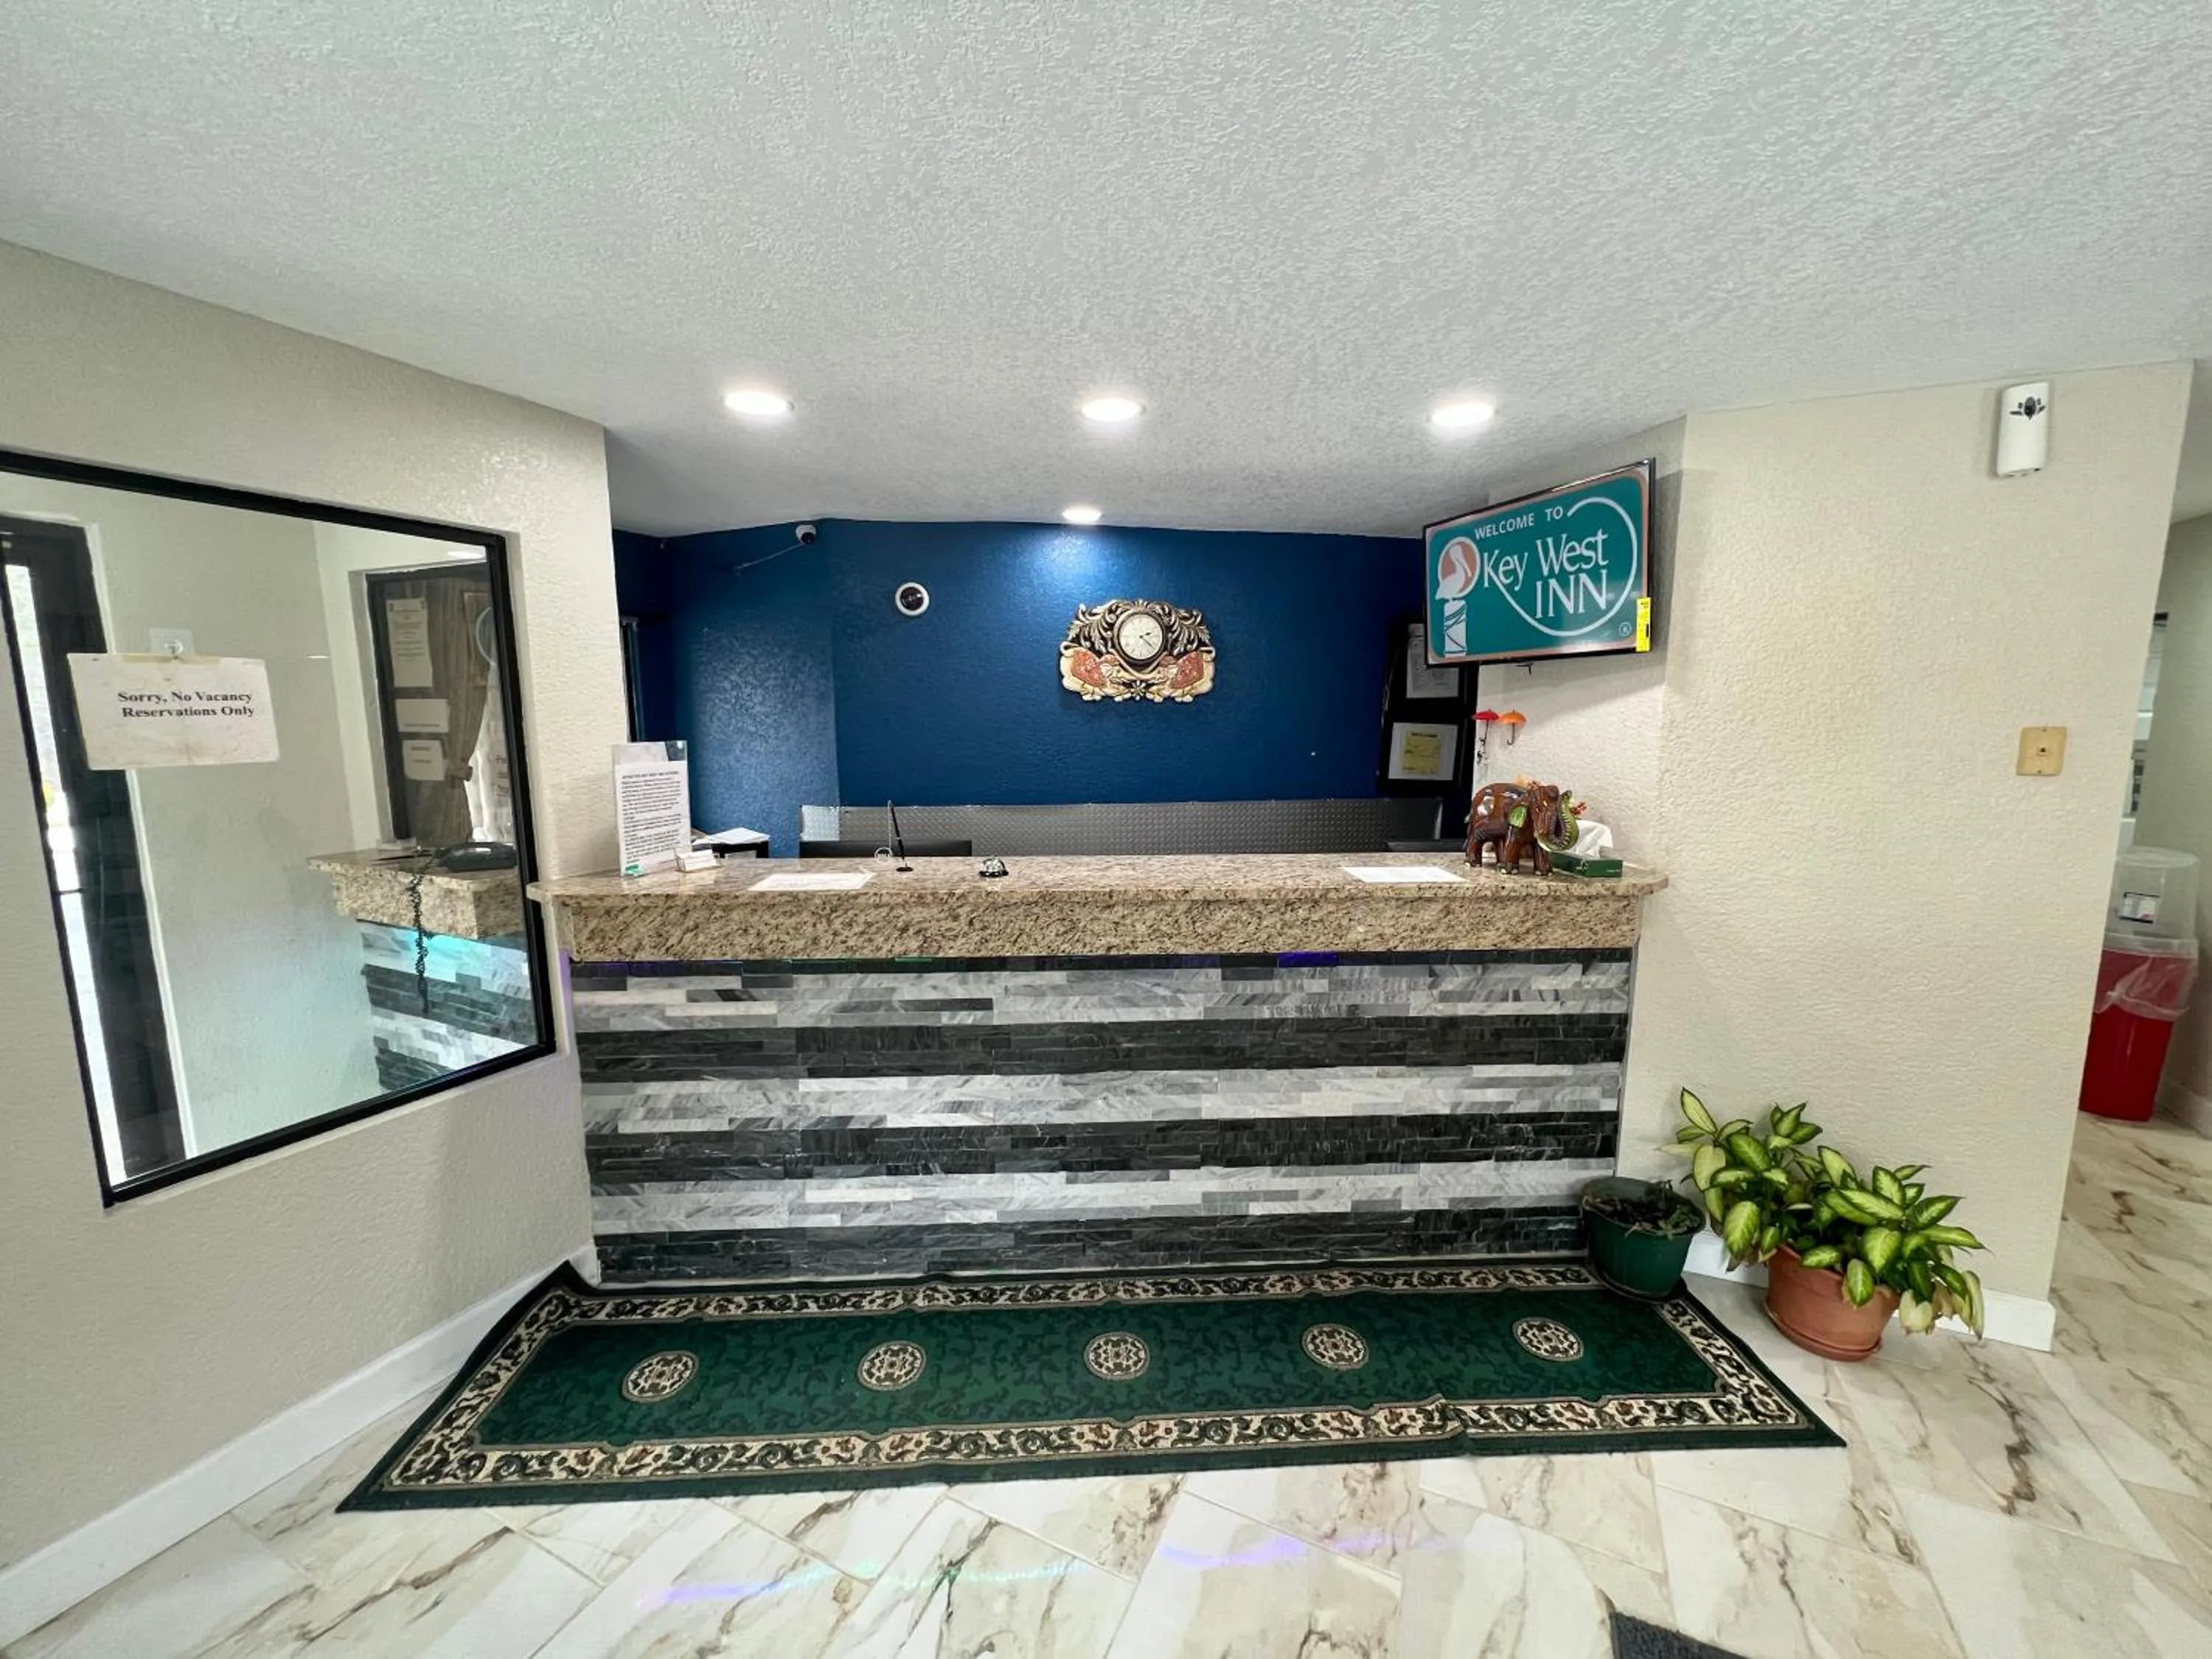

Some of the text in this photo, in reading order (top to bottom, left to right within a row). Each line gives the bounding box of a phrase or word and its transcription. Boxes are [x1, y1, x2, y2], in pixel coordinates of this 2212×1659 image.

[1475, 506, 1564, 540] WELCOME TO
[1484, 528, 1609, 591] Key West
[1535, 568, 1607, 619] INN
[117, 691, 252, 704] Sorry, No Vacancy
[122, 706, 254, 717] Reservations Only
